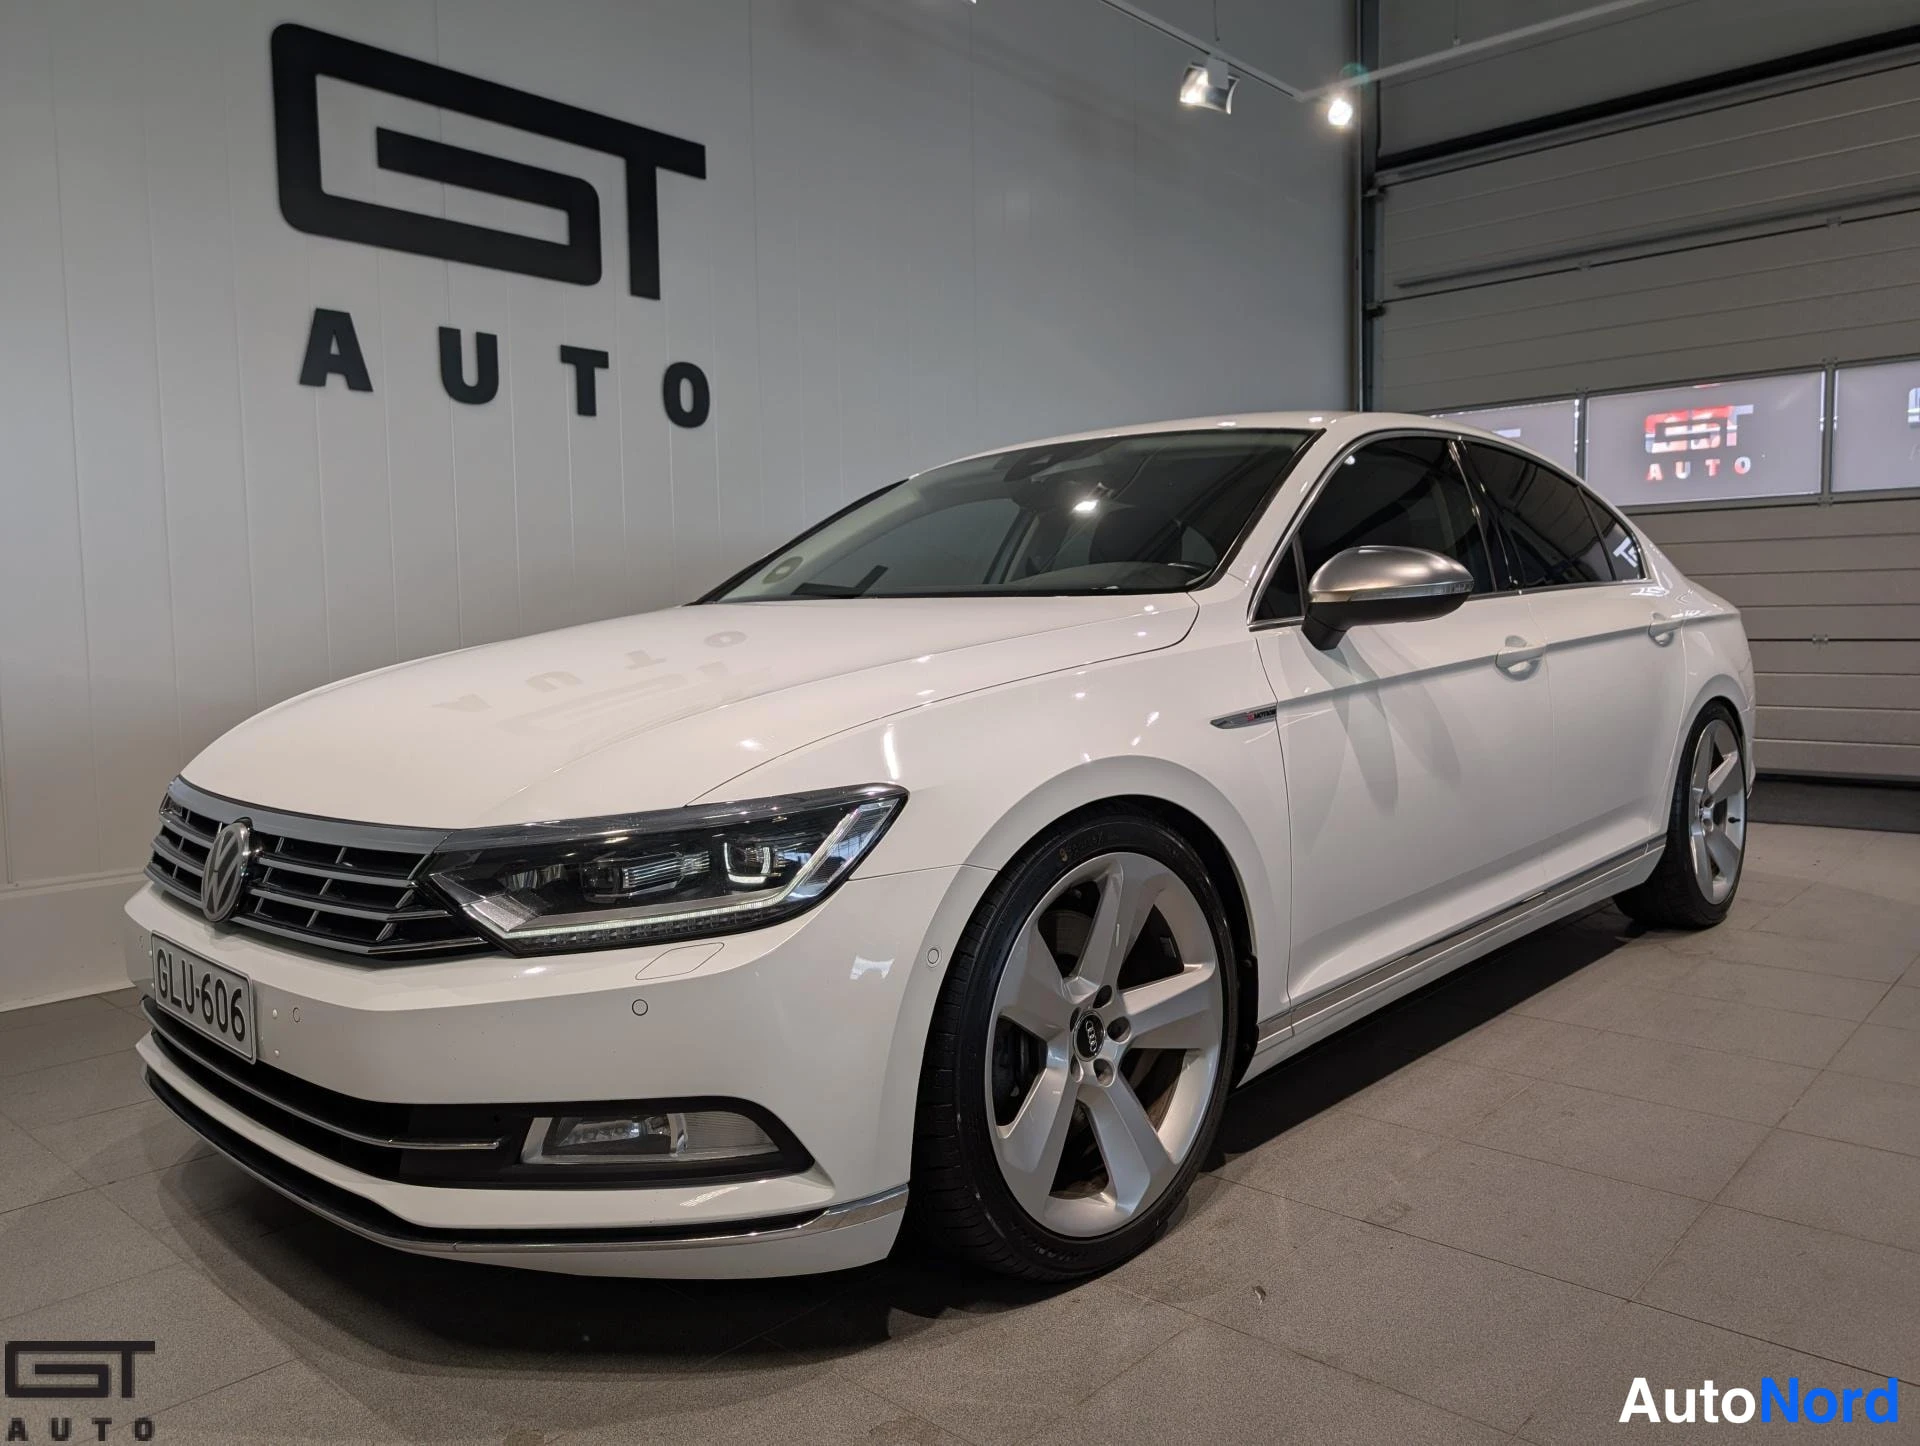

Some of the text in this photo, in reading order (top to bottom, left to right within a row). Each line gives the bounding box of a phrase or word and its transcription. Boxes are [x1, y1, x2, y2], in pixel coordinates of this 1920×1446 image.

[299, 307, 711, 429] AUTO
[1647, 456, 1751, 481] AUTO
[157, 948, 246, 1042] GLU-606
